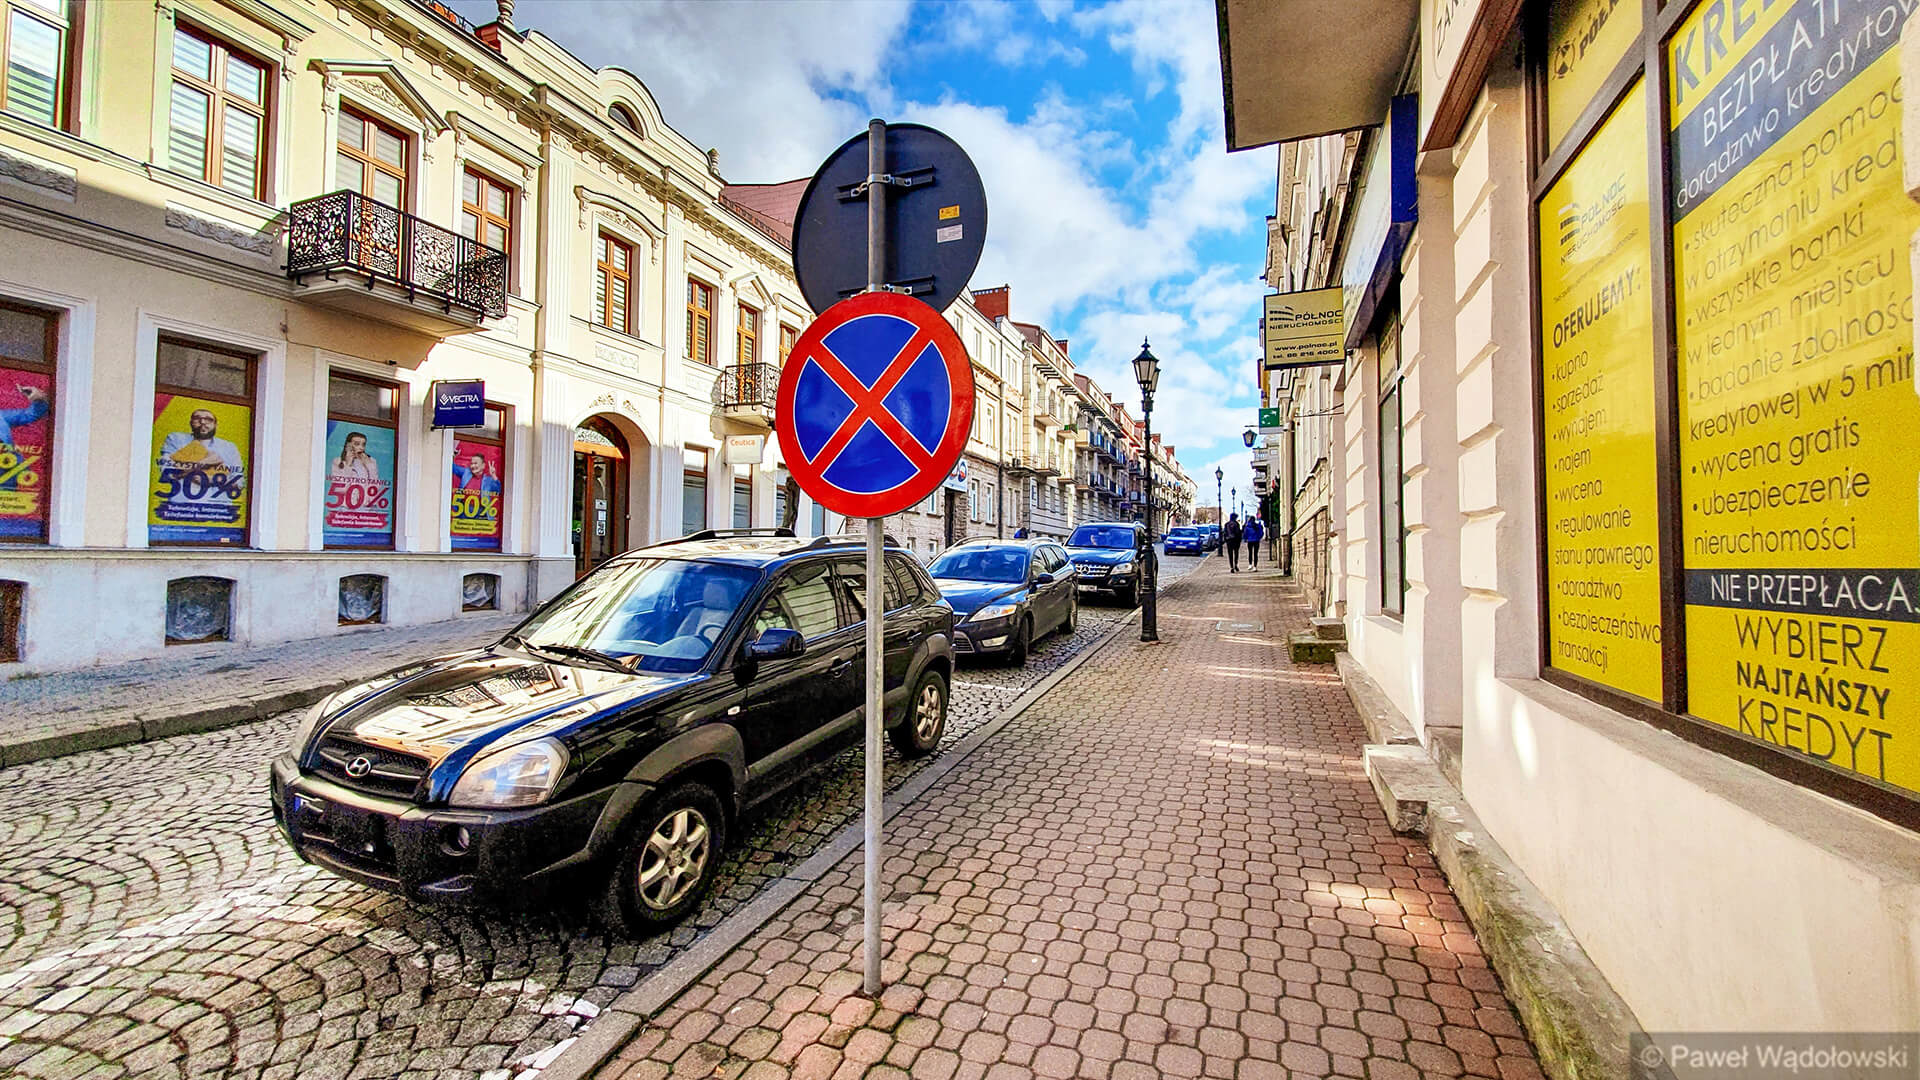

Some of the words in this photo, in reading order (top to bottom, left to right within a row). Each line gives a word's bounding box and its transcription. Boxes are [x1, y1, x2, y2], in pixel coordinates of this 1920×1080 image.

[1676, 0, 1782, 108] KRE
[1686, 273, 1700, 292] w
[1705, 187, 1821, 281] otrzymaniu
[1831, 127, 1902, 200] kred
[1693, 160, 1792, 250] skuteczna
[1695, 261, 1782, 322] wszystkie
[1790, 202, 1865, 272] banki
[1295, 309, 1343, 322] PÓŁNOC
[1552, 264, 1641, 349] OFERUJEMY:
[1687, 347, 1702, 366] w
[1707, 306, 1782, 366] jednym
[1790, 248, 1895, 320] miejscu
[1555, 350, 1589, 383] kupno
[1699, 349, 1784, 401] badanie
[448, 394, 480, 403] VECTRA
[1556, 370, 1605, 414] sprzedaż
[1690, 381, 1800, 442] kredytowej
[1808, 378, 1831, 405] w
[1840, 364, 1855, 398] 5
[1557, 408, 1608, 442] wynajem
[1558, 447, 1592, 475] najem
[1701, 442, 1781, 480] wycena
[1789, 416, 1860, 466] gratis
[154, 468, 244, 500] 50%
[325, 482, 390, 510] 50%
[1559, 479, 1602, 504] wycena
[1702, 466, 1870, 517] ubezpieczenie
[451, 494, 499, 518] 50%
[1560, 503, 1632, 538] regulowanie
[1694, 516, 1856, 555] nieruchomości
[1555, 545, 1583, 565] stanu
[1585, 545, 1654, 571] prawnego
[1562, 576, 1622, 600] doradztwo
[1710, 574, 1741, 602] NIE
[1747, 574, 1920, 613] PRZEPŁACA
[1562, 606, 1662, 645] bezpieczeństwo
[1734, 613, 1890, 674] WYBIERZ
[1558, 635, 1608, 675] transakcji
[1736, 660, 1890, 720] NAJTAŃSZY
[1738, 695, 1892, 781] KREDYT
